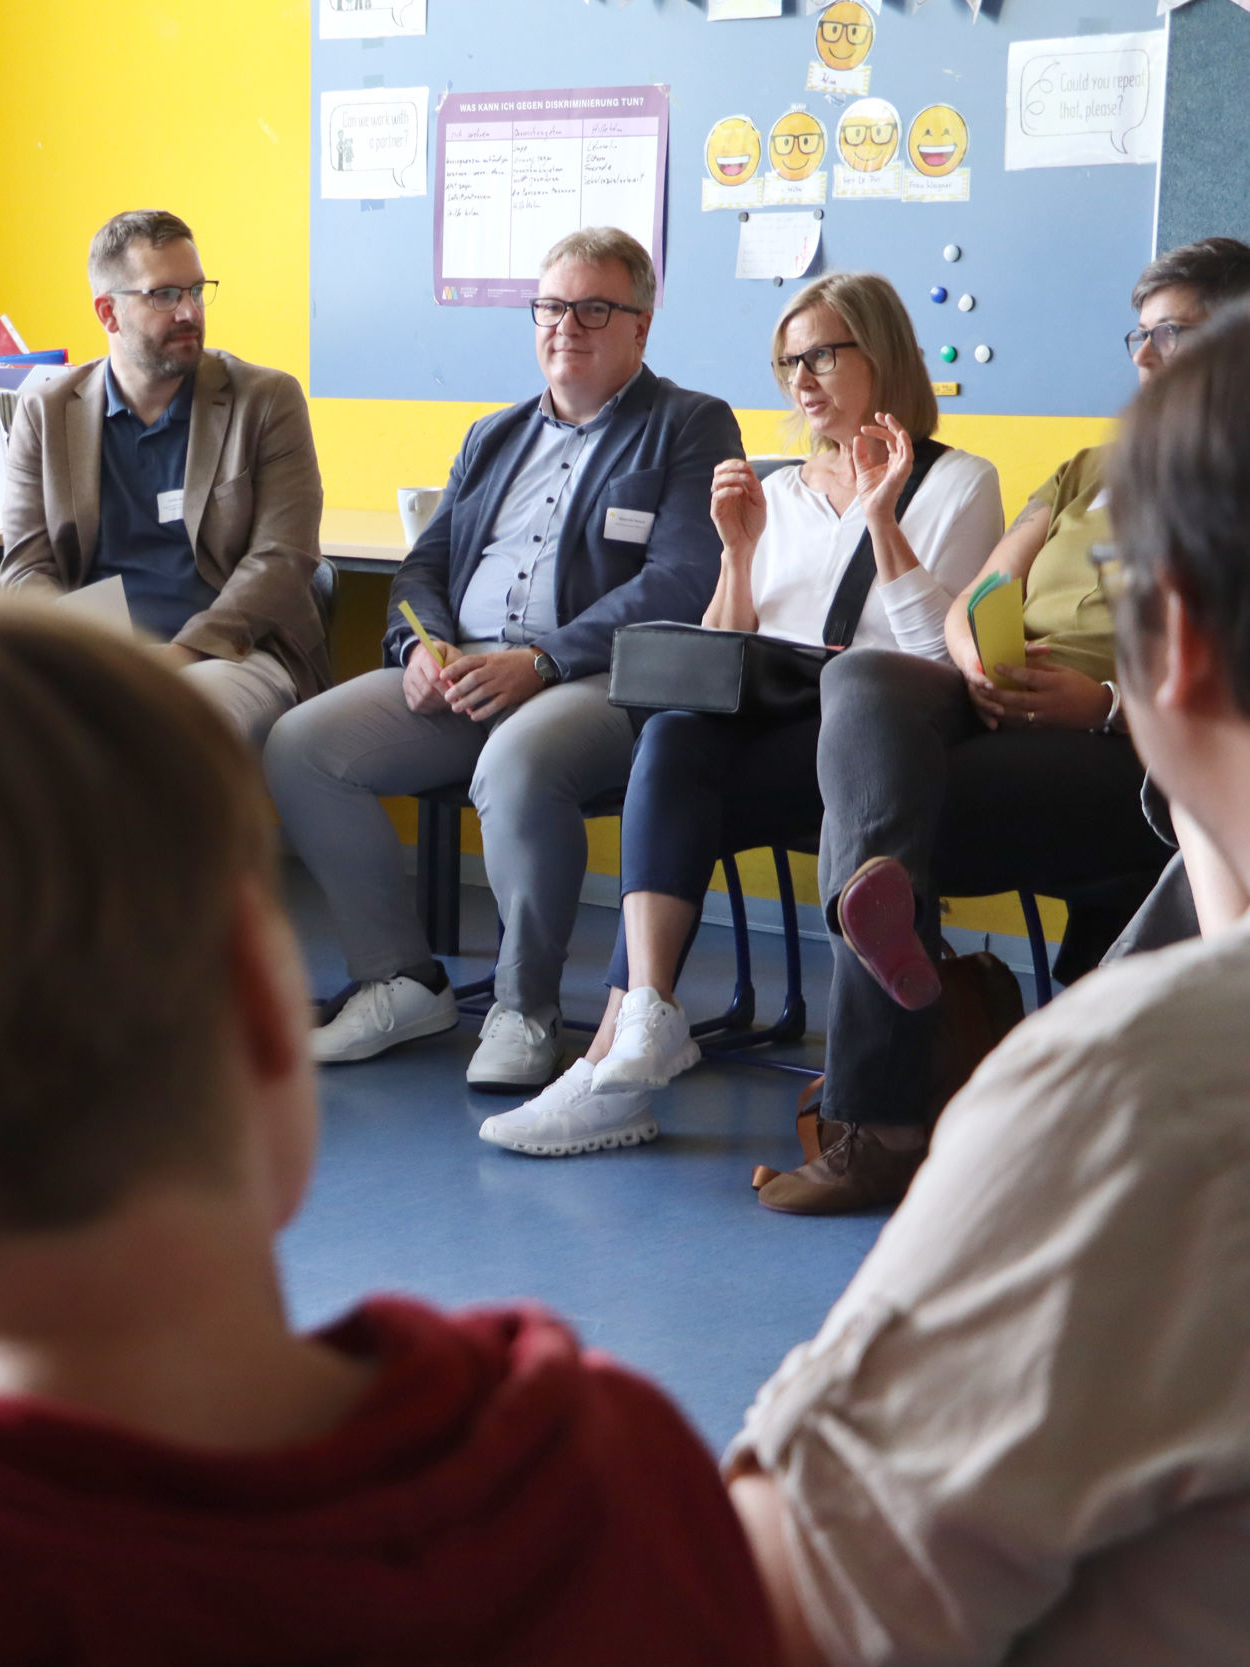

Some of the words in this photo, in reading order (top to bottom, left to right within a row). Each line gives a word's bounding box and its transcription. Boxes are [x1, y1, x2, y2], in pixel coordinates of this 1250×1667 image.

[1060, 72, 1089, 92] Could
[1092, 76, 1110, 91] you
[1113, 72, 1146, 96] repeat
[459, 103, 476, 113] WAS
[478, 102, 499, 112] KANN
[501, 102, 514, 111] ICH
[516, 101, 543, 111] GEGEN
[545, 98, 619, 110] DISKRIMINIERUNG
[621, 97, 644, 107] TUN?
[1085, 95, 1124, 122] please?
[342, 111, 357, 128] Can
[358, 116, 369, 127] we
[371, 111, 390, 127] work
[391, 108, 409, 125] with
[375, 130, 409, 152] partner?
